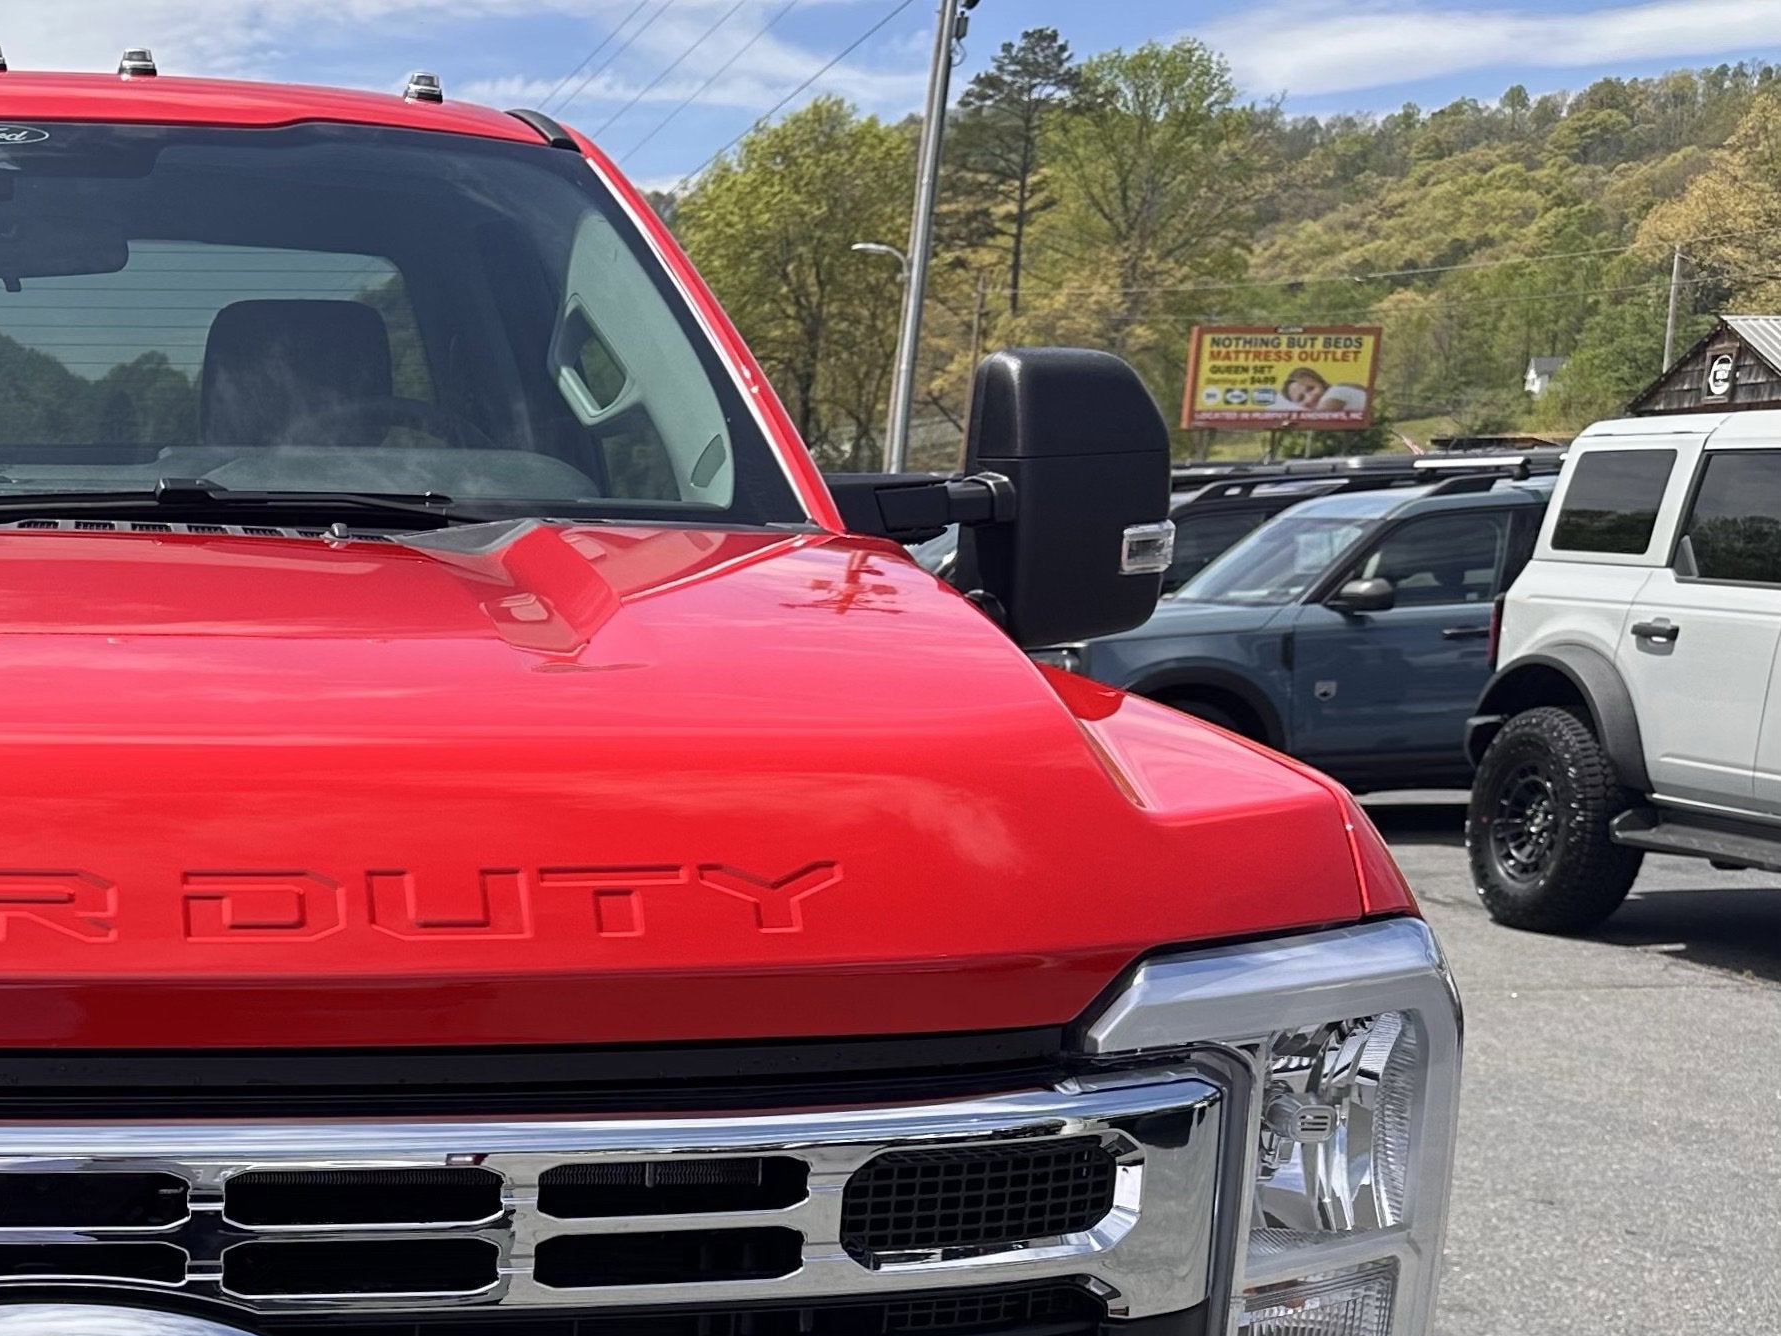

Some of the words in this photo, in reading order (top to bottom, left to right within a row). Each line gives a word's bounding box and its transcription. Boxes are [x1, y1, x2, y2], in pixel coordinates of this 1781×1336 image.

[1210, 336, 1281, 349] NOTHING
[1286, 336, 1318, 349] BUT
[1322, 336, 1363, 349] BEDS
[1208, 350, 1292, 362] MATTRESS
[1297, 350, 1361, 362] OUTLET
[1209, 364, 1250, 375] QUEEN
[1252, 364, 1275, 375] SET
[180, 860, 844, 944] DUTY
